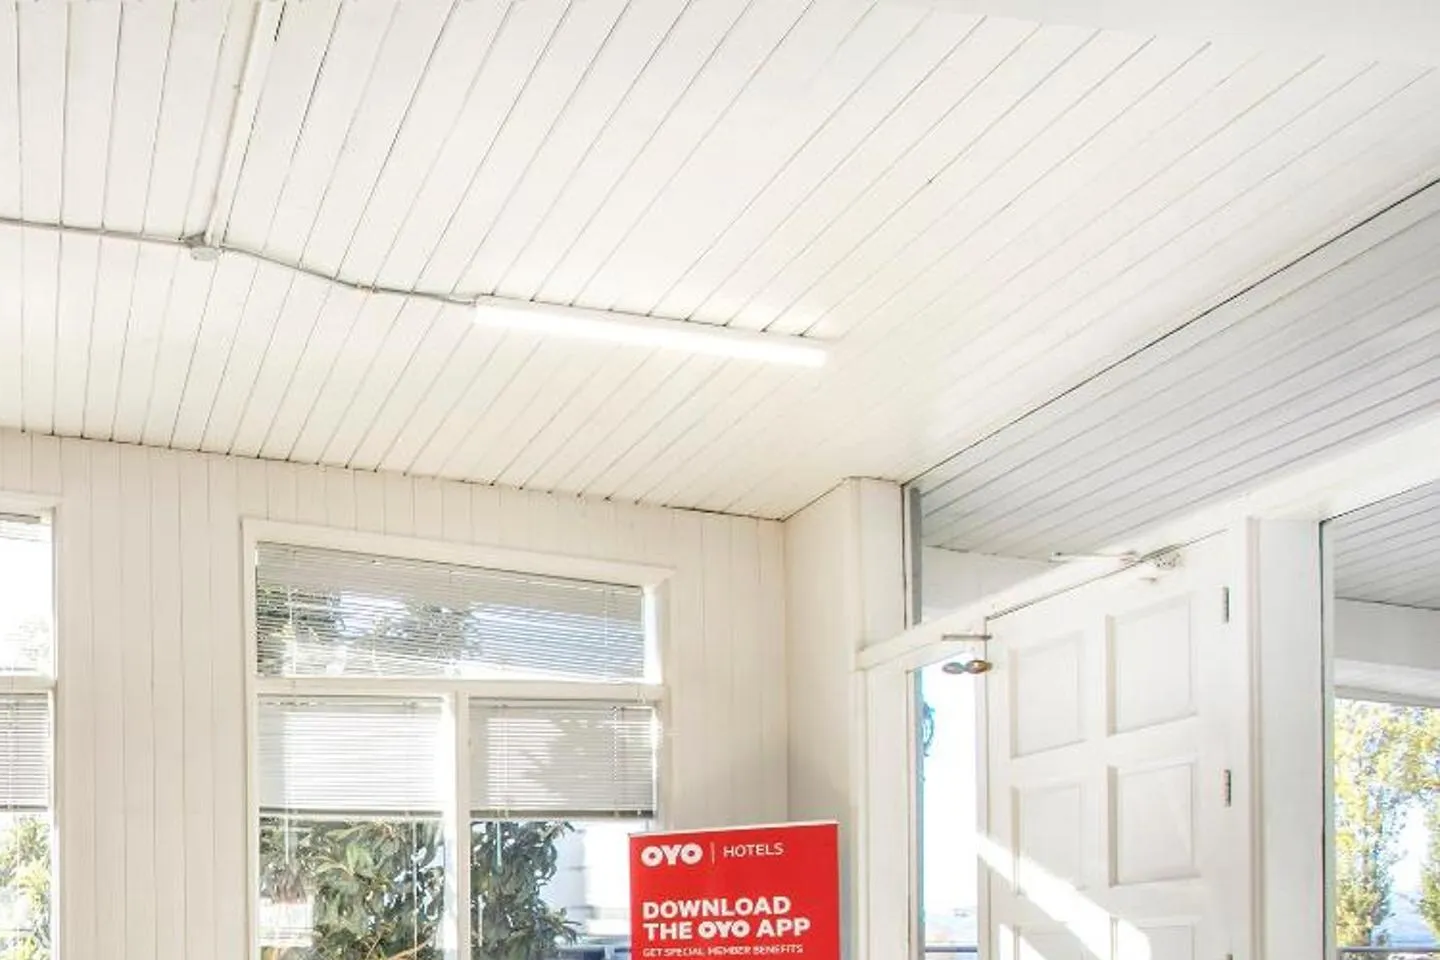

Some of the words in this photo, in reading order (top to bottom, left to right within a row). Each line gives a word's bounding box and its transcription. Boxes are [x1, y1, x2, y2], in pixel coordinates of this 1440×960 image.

[641, 842, 704, 867] OYO
[723, 842, 784, 858] HOTELS
[642, 896, 791, 920] DOWNLOAD
[642, 922, 693, 942] THE
[698, 920, 751, 940] OYO
[756, 917, 811, 938] APP
[643, 947, 661, 958] GET
[663, 946, 704, 957] SPECIAL
[707, 945, 751, 956] MEMBER
[753, 944, 804, 955] BENEFITS
